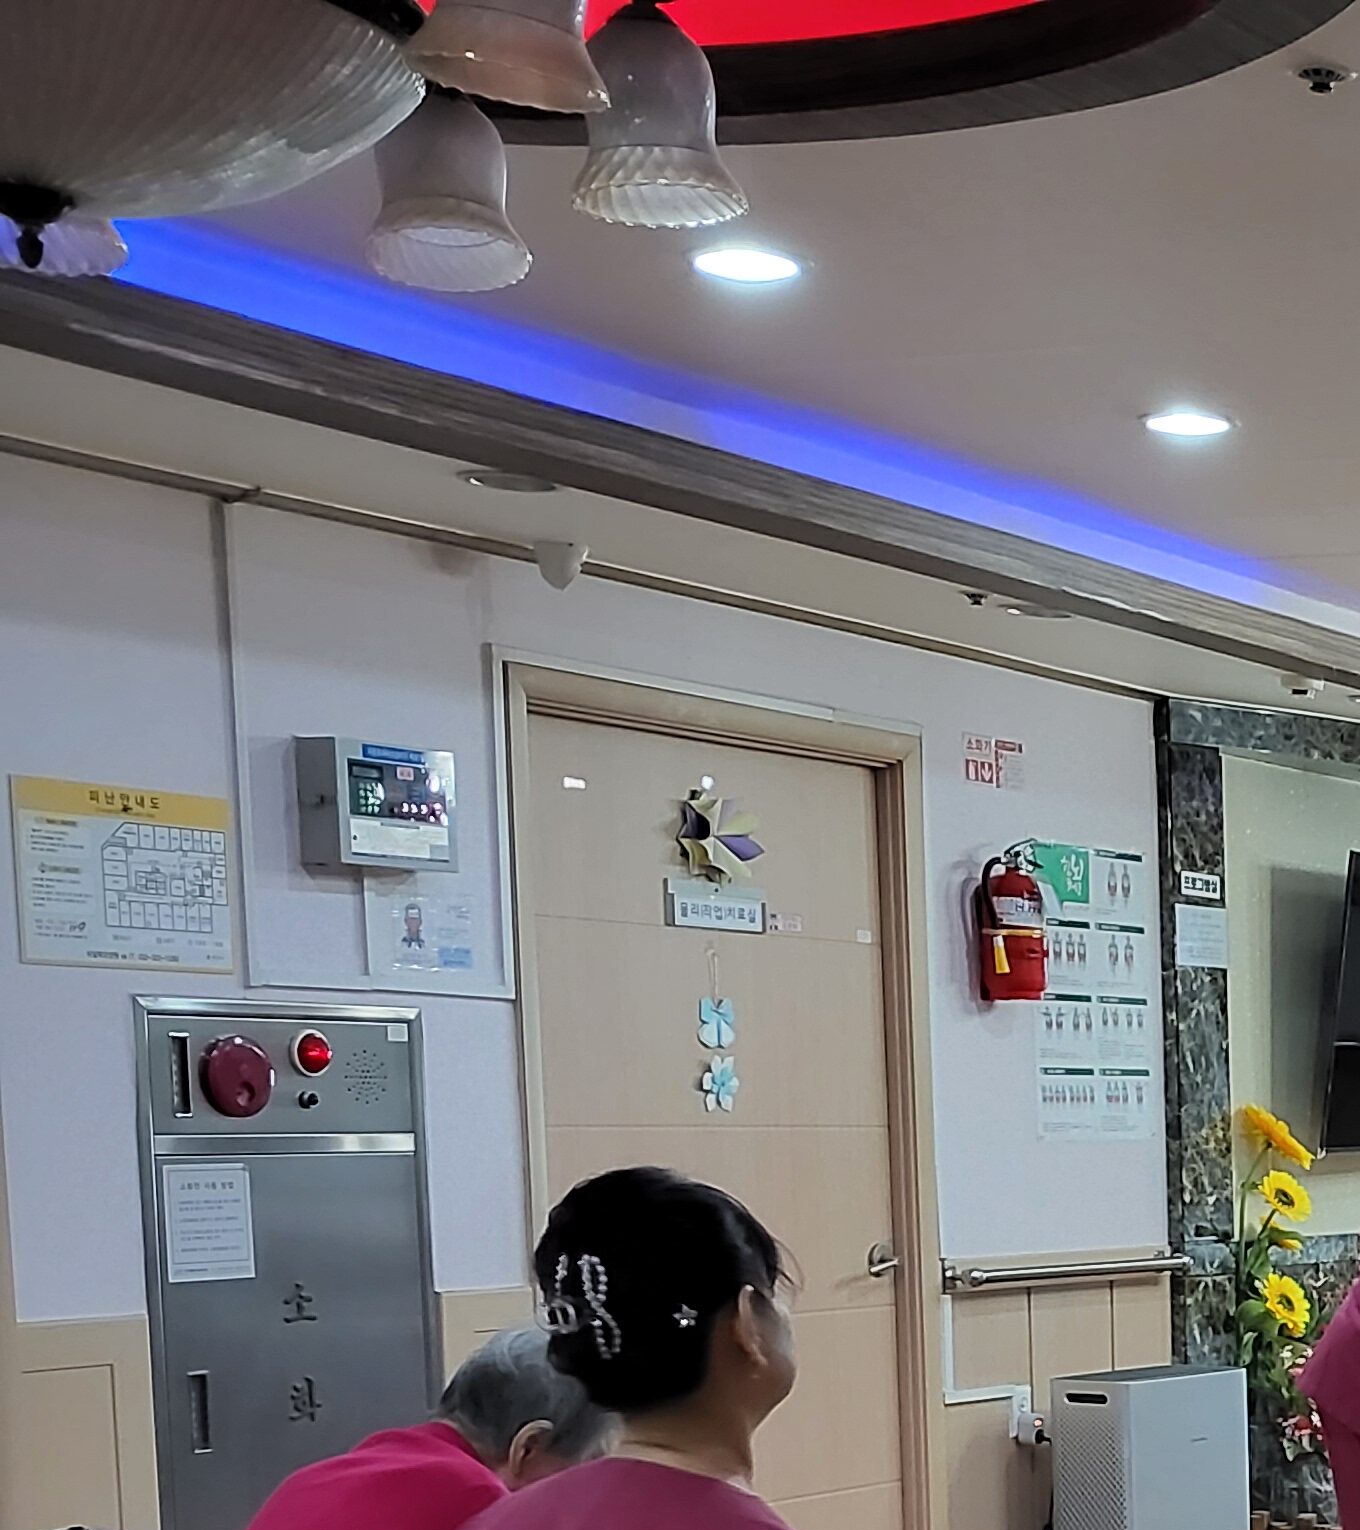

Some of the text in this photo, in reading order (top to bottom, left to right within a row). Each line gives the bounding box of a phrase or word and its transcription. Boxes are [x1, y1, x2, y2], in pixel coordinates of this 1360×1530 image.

[89, 789, 161, 810] 피난안내도
[1184, 876, 1217, 894] 프로그램실
[680, 901, 757, 924] 물리(작업)치료실
